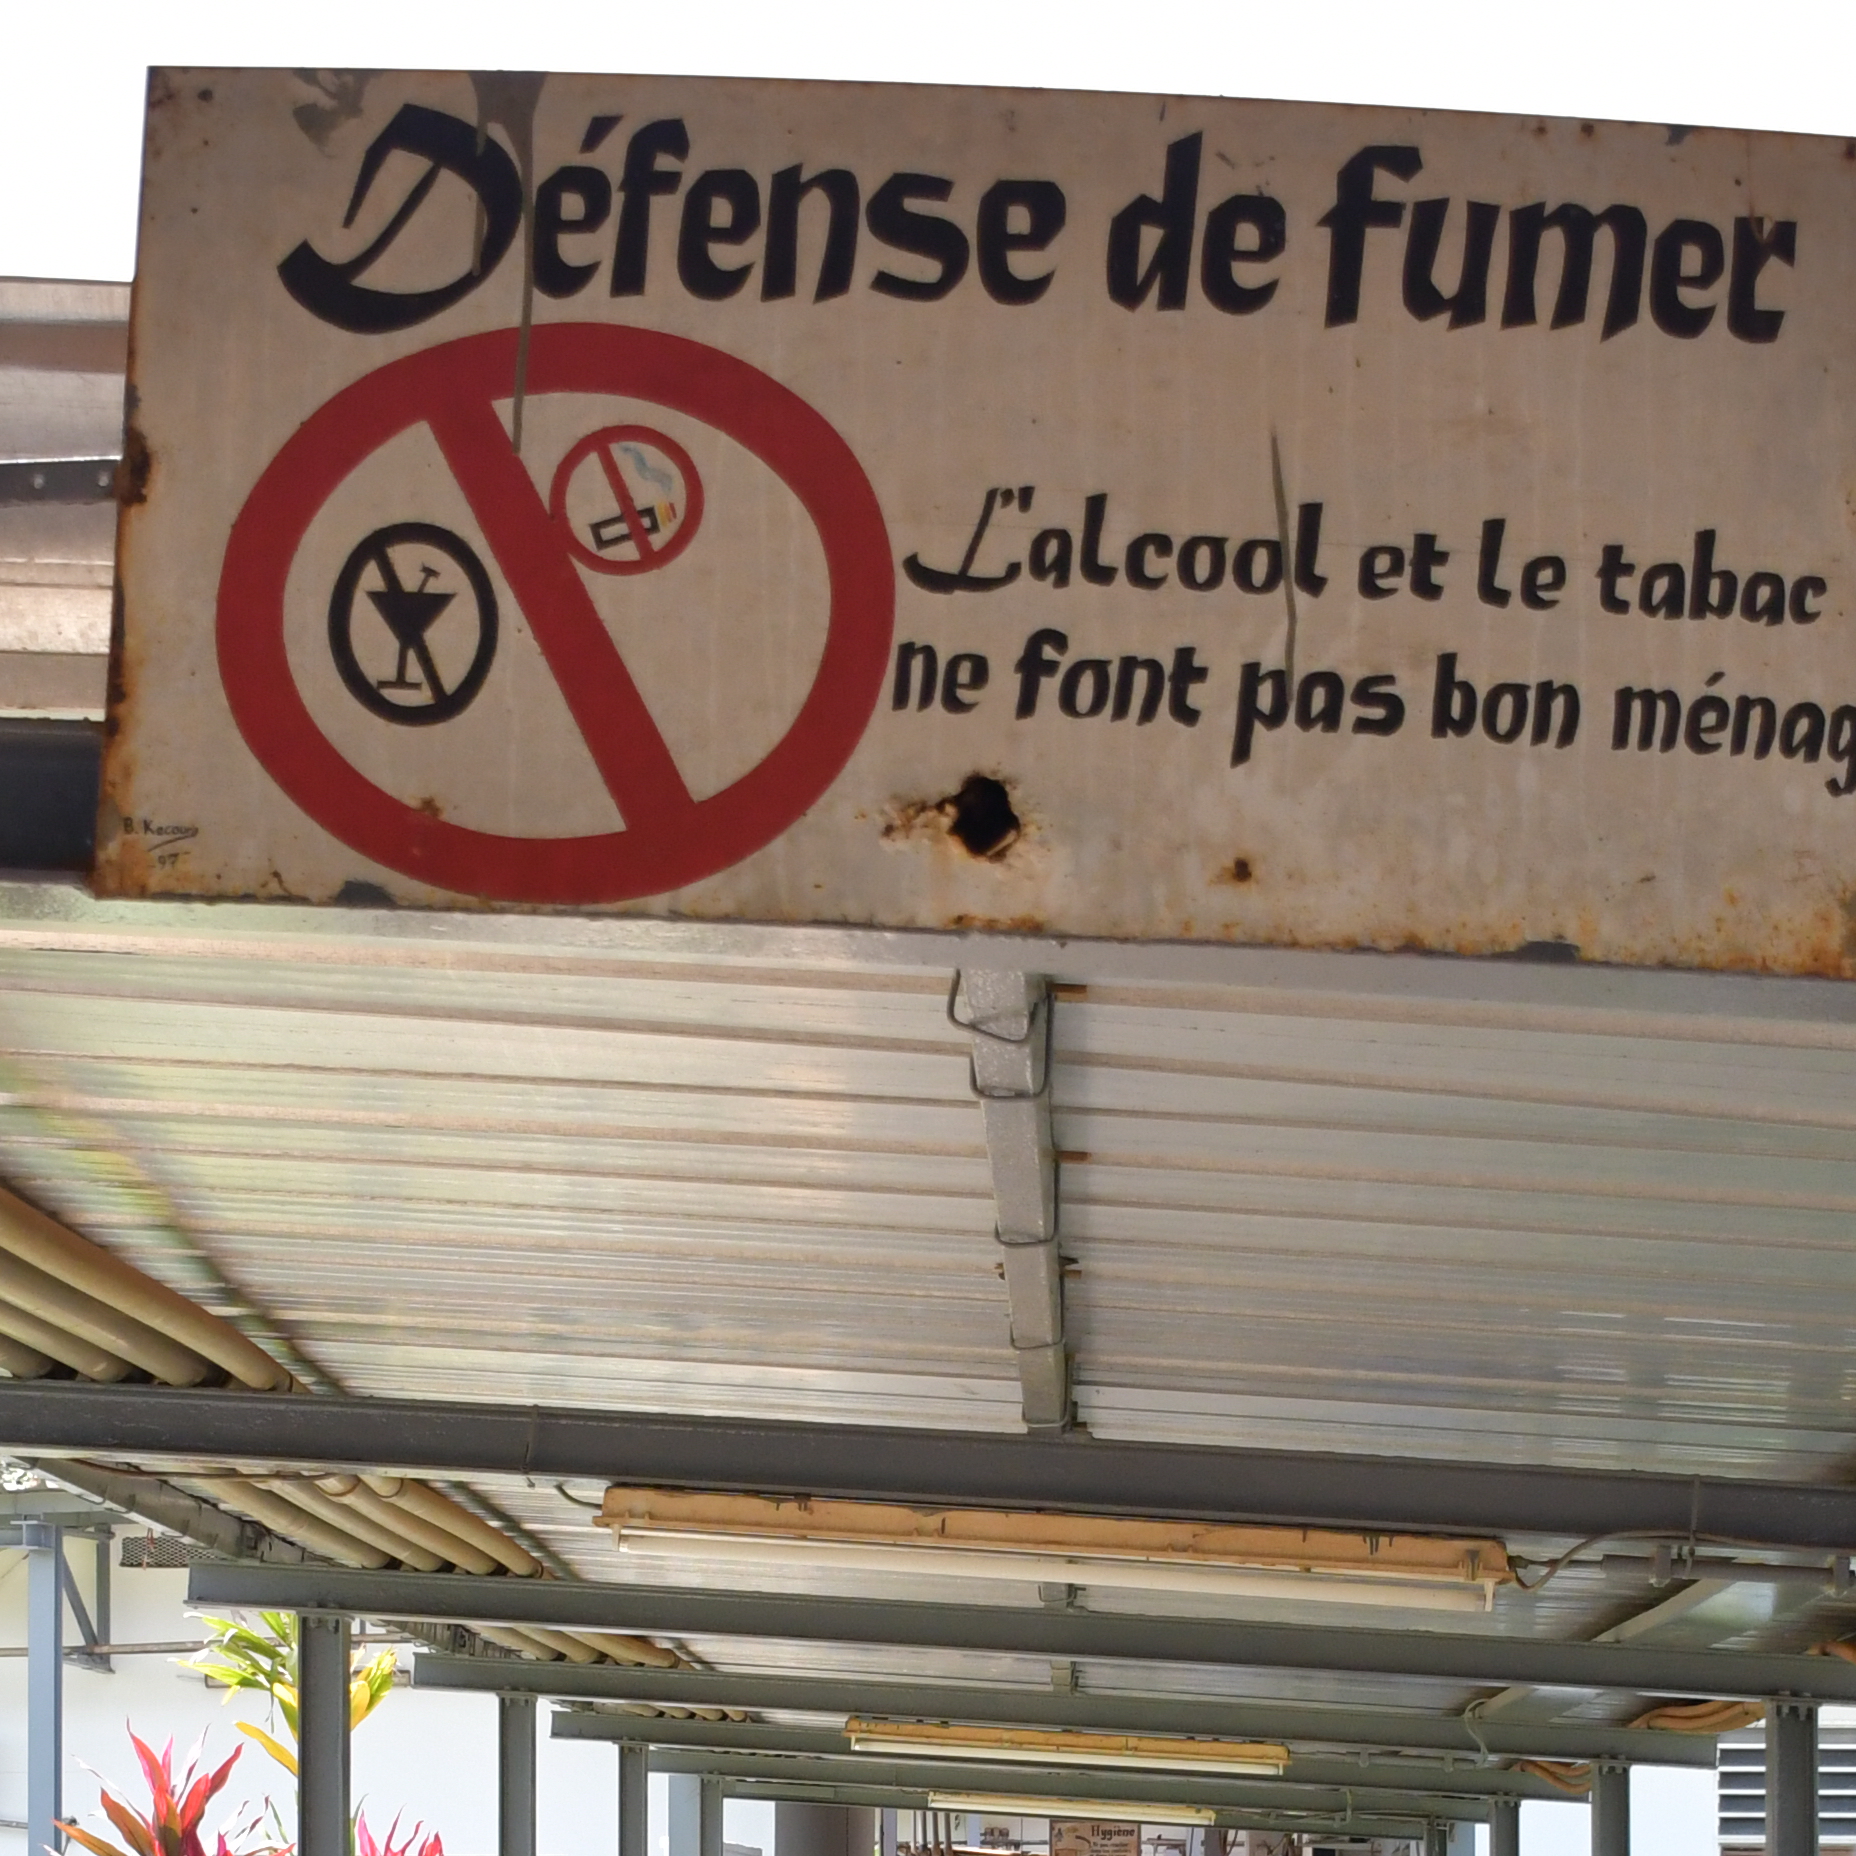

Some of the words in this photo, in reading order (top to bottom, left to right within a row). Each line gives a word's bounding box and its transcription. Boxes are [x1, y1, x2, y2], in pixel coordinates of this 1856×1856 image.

[276, 102, 1068, 336] Défense
[1105, 129, 1287, 317] de
[1315, 144, 1799, 344] fumer
[1357, 532, 1450, 602] et
[1476, 517, 1567, 612] le
[1595, 528, 1828, 627] tabac
[891, 641, 990, 715] ne
[1014, 627, 1210, 729] font
[1230, 660, 1407, 770] pas
[1430, 652, 1581, 750] bon
[1091, 1825, 1135, 1840] Hygiène
